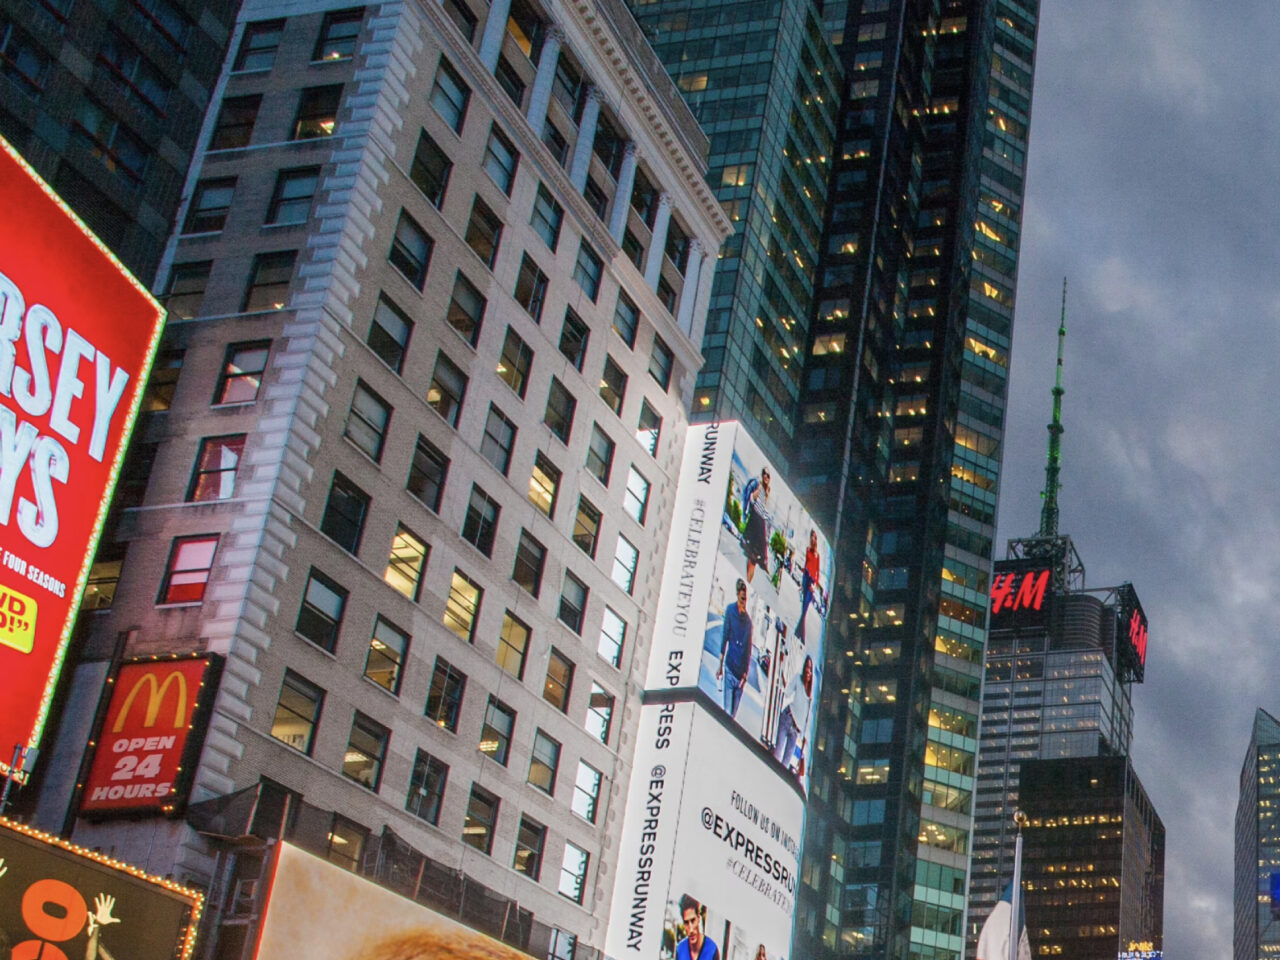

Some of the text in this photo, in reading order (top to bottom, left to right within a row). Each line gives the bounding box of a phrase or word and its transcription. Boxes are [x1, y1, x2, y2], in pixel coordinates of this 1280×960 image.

[697, 422, 720, 485] RUNWAY
[3, 551, 66, 599] FOUR SEASONS
[666, 651, 683, 686] EXP
[112, 736, 175, 753] OPEN
[112, 755, 161, 781] 24
[92, 782, 170, 801] HOURS
[730, 790, 759, 825] FOLLOW
